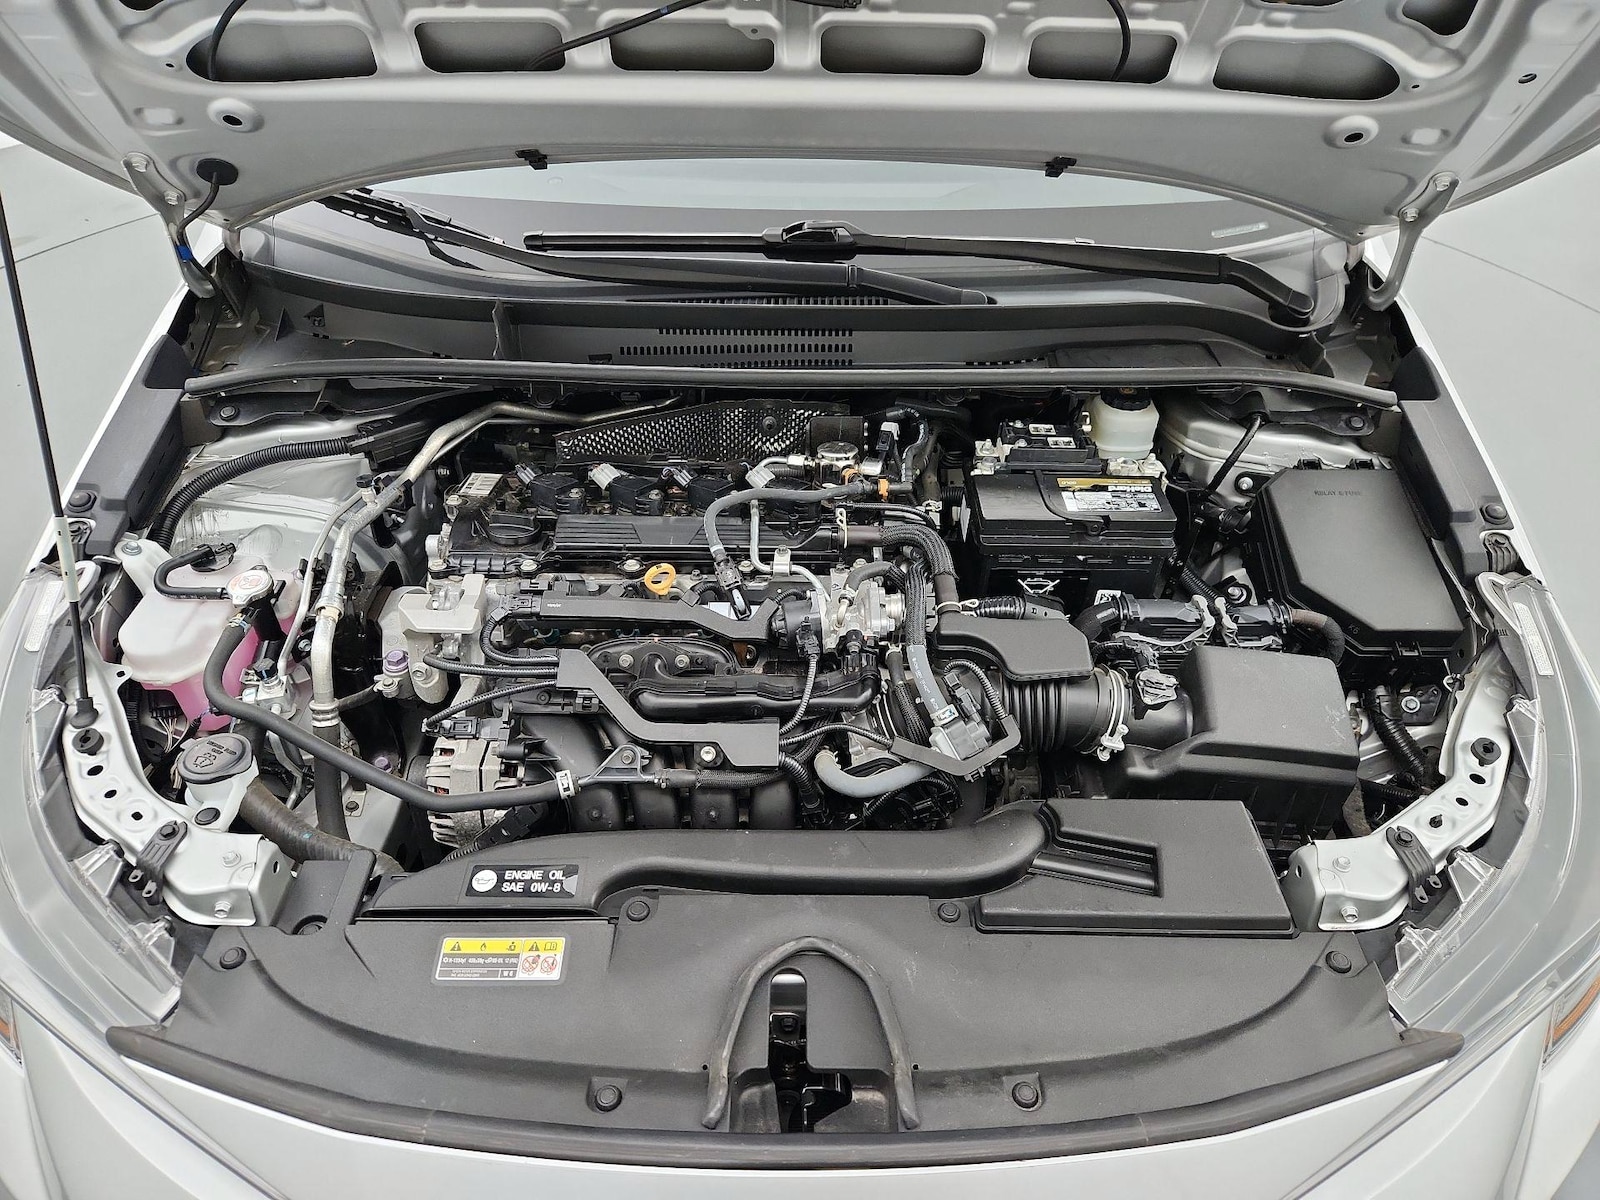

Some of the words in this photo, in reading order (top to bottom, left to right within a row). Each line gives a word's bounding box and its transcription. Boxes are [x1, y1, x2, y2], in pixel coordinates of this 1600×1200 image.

[1107, 485, 1153, 493] DieHard
[504, 870, 544, 880] ENGINE
[548, 870, 566, 880] OIL
[501, 882, 525, 892] SAE
[530, 882, 561, 893] 0W-8
